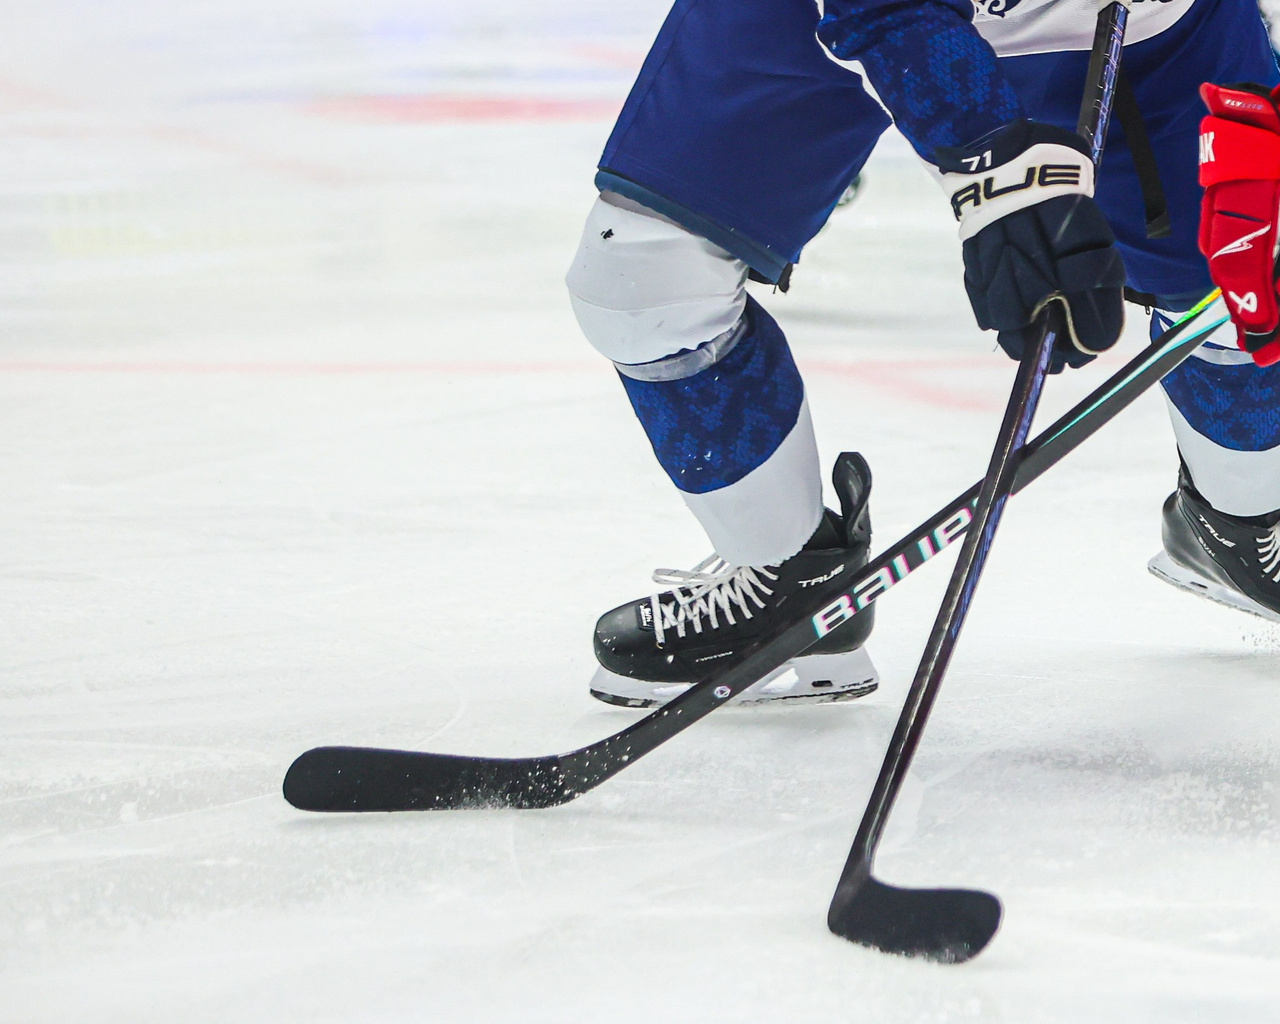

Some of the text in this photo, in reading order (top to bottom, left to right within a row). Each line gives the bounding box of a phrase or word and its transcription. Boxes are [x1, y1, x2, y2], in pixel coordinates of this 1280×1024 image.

[961, 150, 992, 171] 71
[951, 164, 1081, 222] RUE
[1199, 513, 1237, 549] TRUE
[798, 564, 845, 588] TRUE
